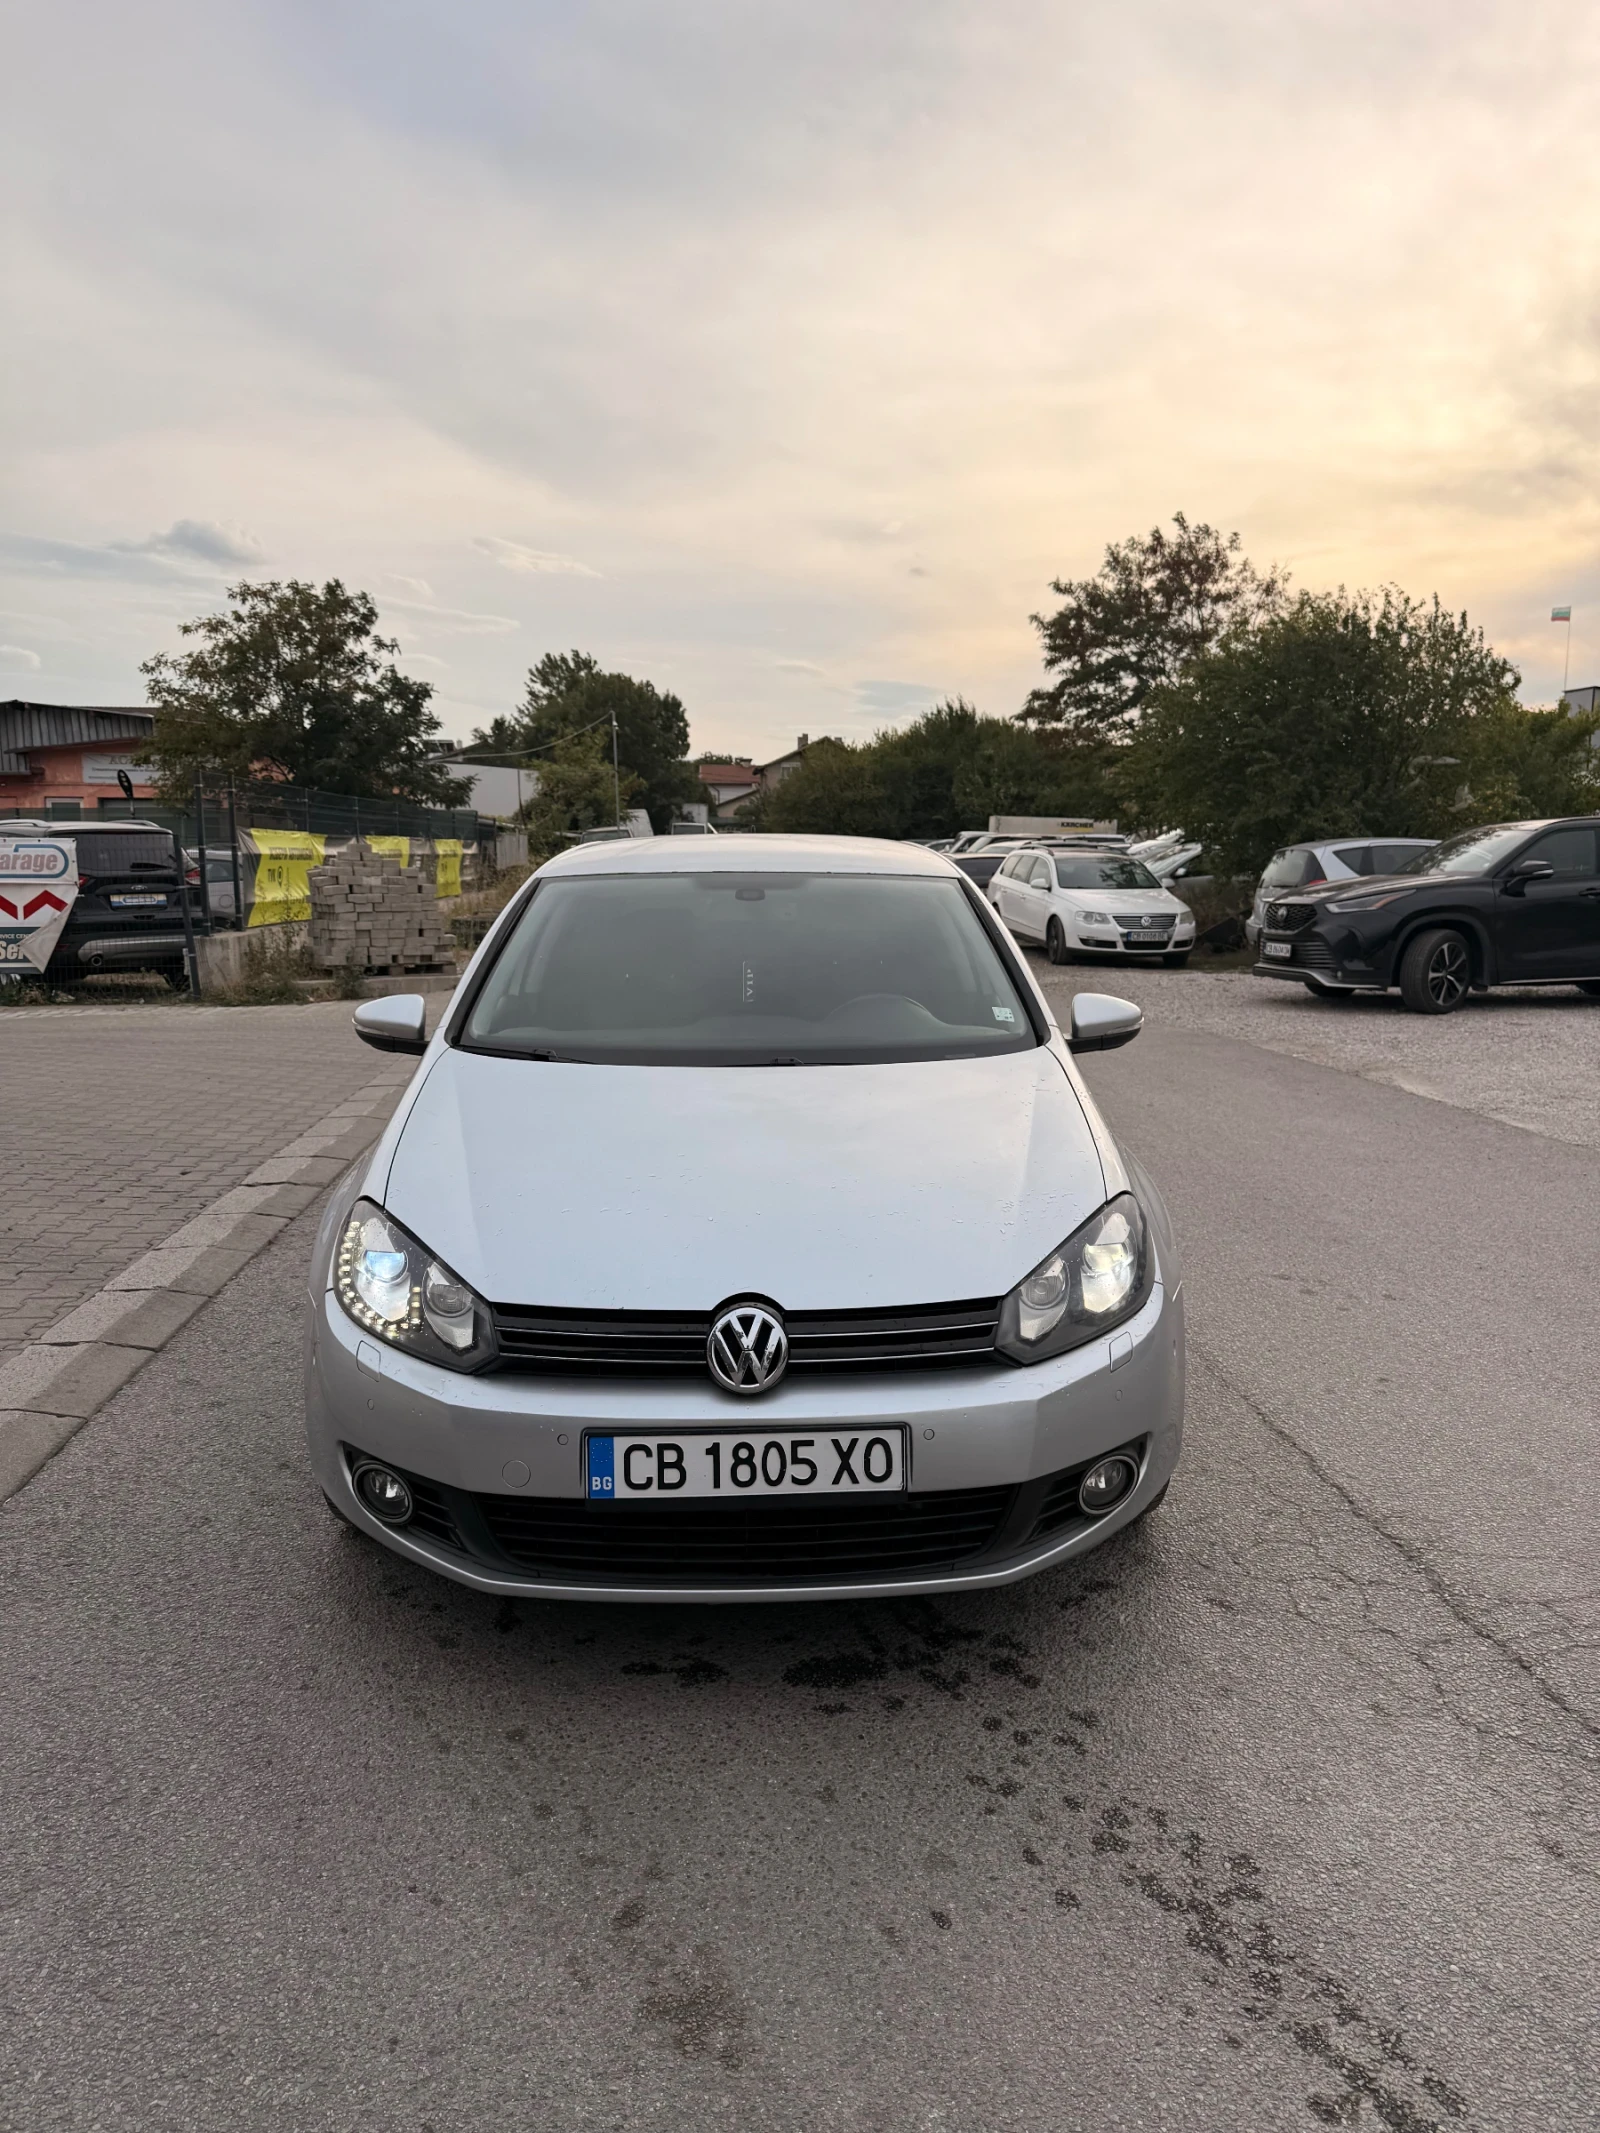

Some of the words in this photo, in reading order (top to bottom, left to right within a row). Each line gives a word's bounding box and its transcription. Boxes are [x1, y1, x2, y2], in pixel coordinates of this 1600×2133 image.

[591, 1477, 613, 1491] BG
[623, 1443, 687, 1490] CB
[705, 1440, 818, 1489] 1805
[831, 1437, 893, 1485] XO
